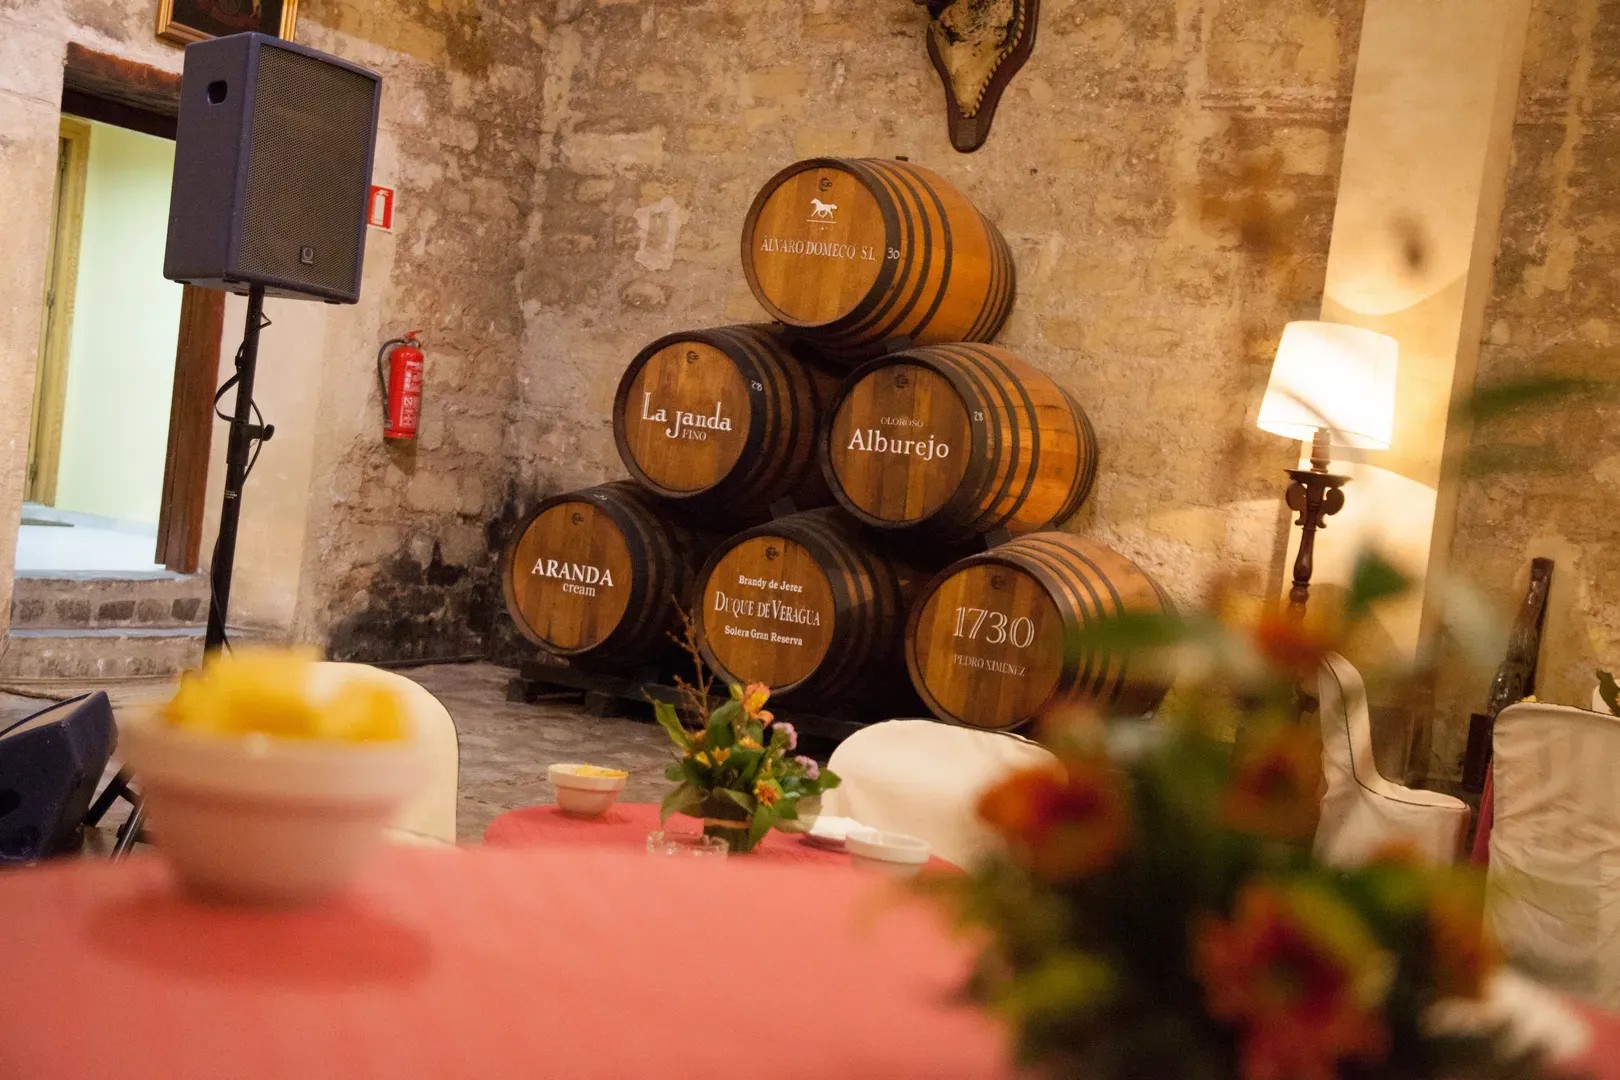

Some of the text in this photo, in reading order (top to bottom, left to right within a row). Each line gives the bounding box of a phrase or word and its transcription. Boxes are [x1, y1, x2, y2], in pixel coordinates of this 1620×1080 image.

[642, 392, 667, 422] La
[880, 416, 924, 428] OLOROSO
[682, 429, 707, 441] FINO
[847, 428, 949, 461] Alburejo
[531, 558, 614, 587] ARANDA
[562, 583, 596, 597] cream
[739, 575, 803, 593] Brandy de Jerez
[757, 602, 771, 618] DE
[772, 600, 821, 626] VERAGUA
[724, 625, 803, 646] Solera Gran Reserva
[953, 606, 1035, 648] 1730
[953, 654, 985, 669] PEDRO
